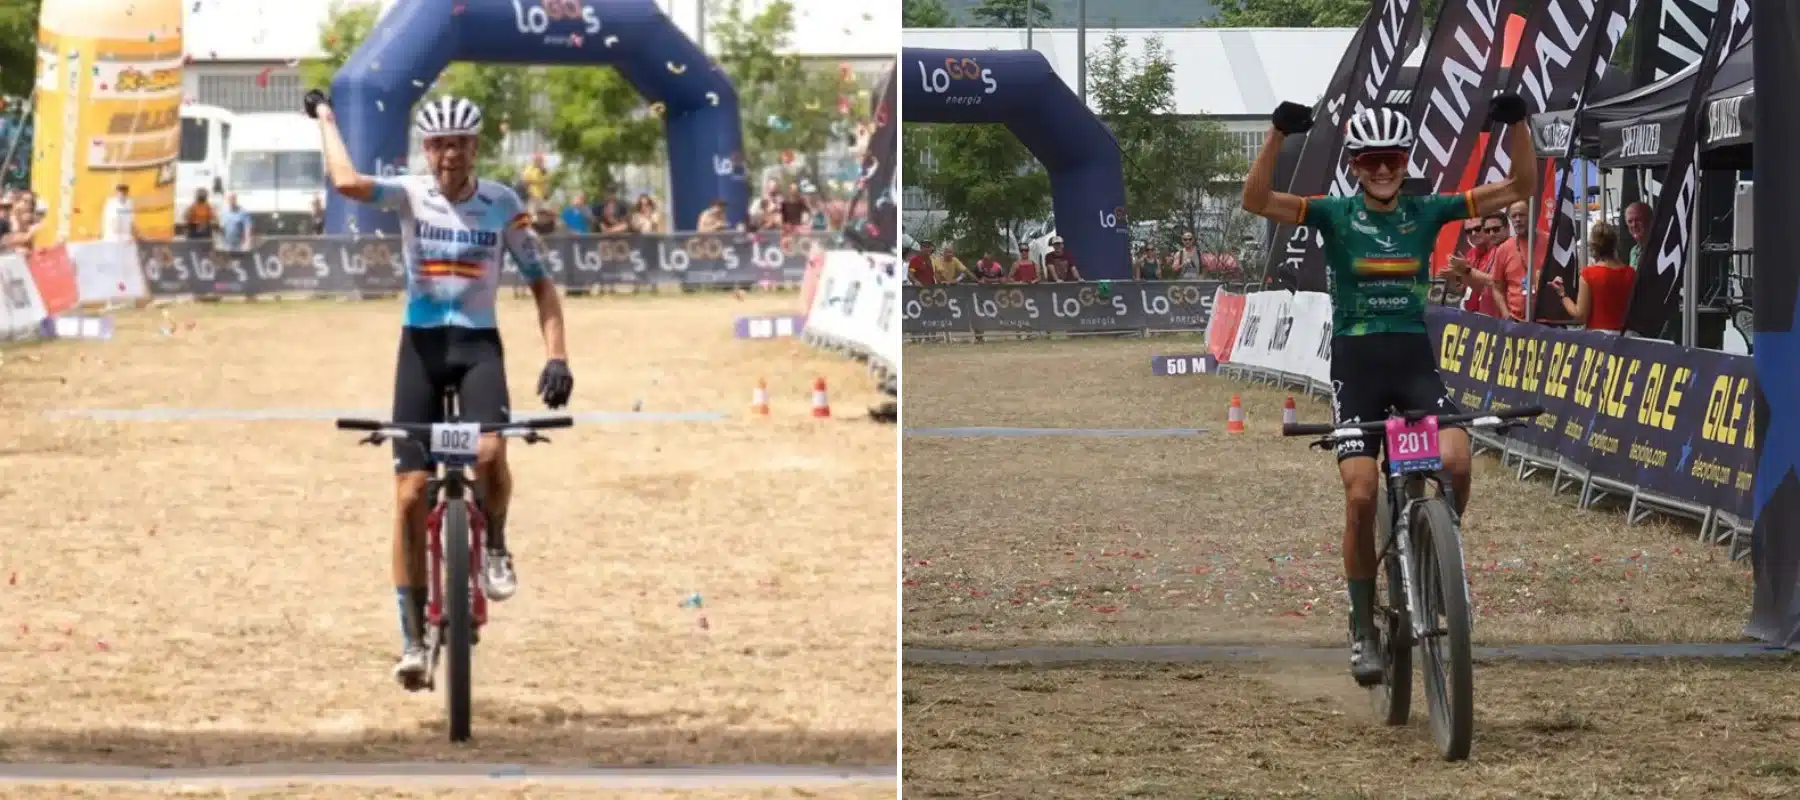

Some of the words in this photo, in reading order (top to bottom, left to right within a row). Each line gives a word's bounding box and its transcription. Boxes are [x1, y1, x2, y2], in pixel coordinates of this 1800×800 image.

[1166, 358, 1183, 374] 50
[1192, 357, 1207, 373] M
[441, 430, 472, 450] 002
[1398, 431, 1429, 454] 201
